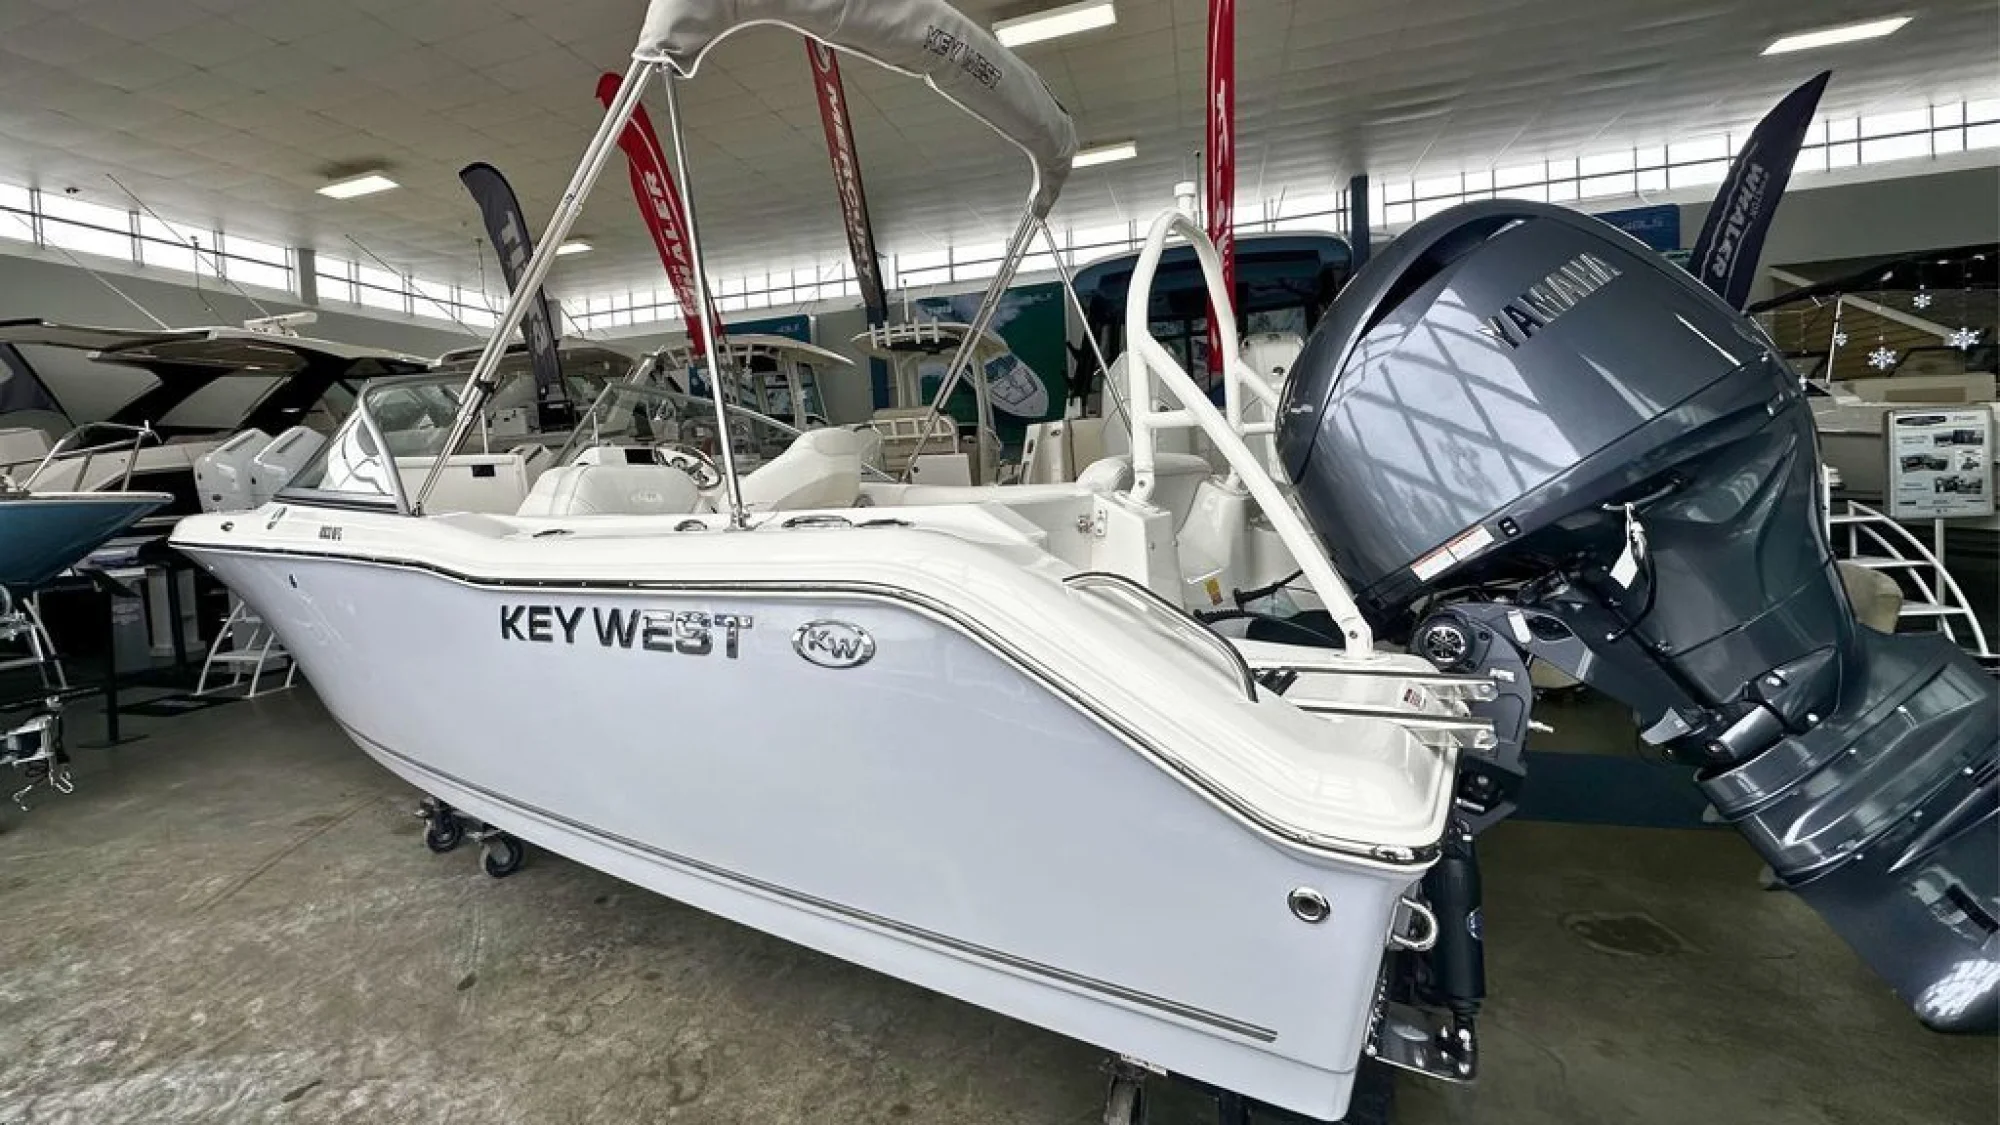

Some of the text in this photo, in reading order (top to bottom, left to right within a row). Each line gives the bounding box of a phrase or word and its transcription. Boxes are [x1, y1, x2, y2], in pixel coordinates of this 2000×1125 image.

[924, 25, 1003, 89] KEY WEST
[1712, 163, 1764, 278] WHALER
[1477, 252, 1624, 350] YAMAHA
[500, 604, 753, 659] KEY WEST
[807, 629, 862, 659] KW
